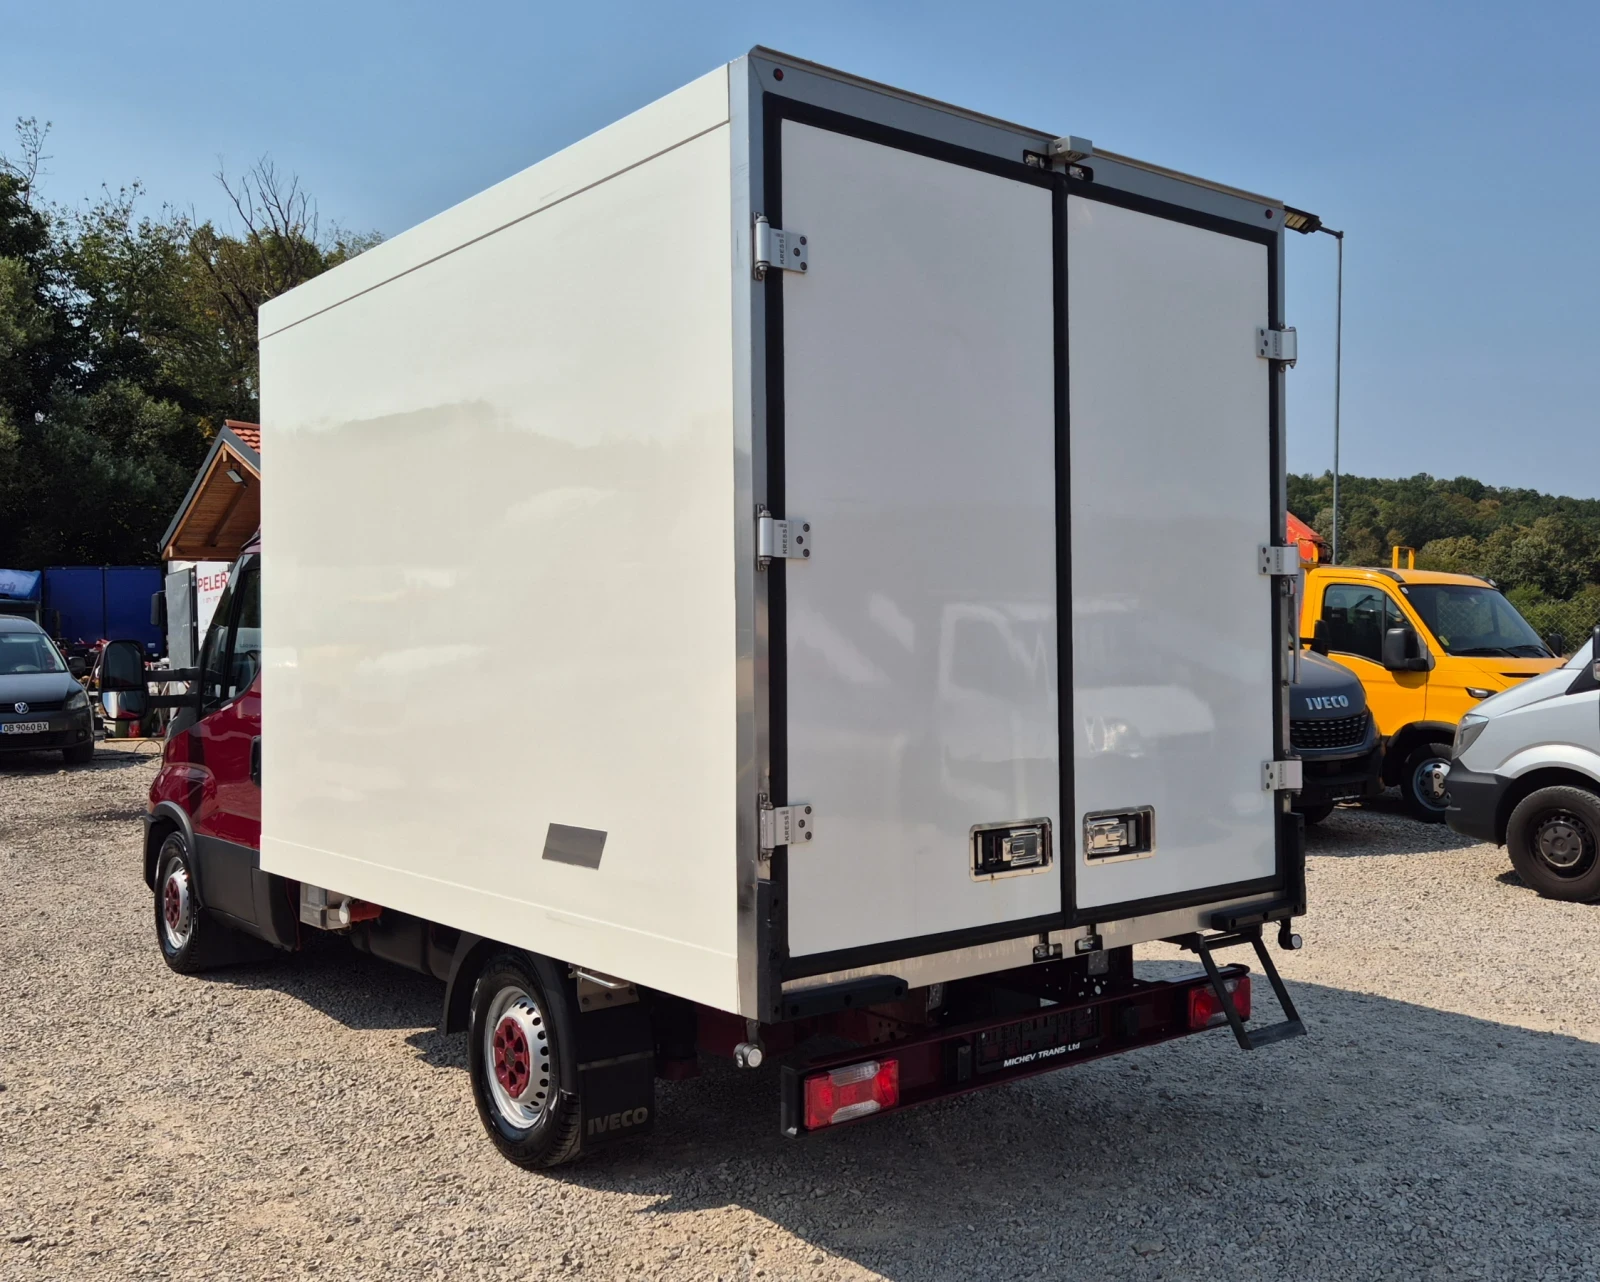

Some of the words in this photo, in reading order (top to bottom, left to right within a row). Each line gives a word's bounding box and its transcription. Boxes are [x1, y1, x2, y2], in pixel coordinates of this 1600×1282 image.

[1305, 695, 1349, 710] IVECO
[16, 723, 36, 731] 9060
[1003, 1053, 1036, 1067] MICHEV
[1038, 1045, 1066, 1058] TRANS
[1068, 1041, 1081, 1051] Ltd
[587, 1106, 649, 1136] IVECO
